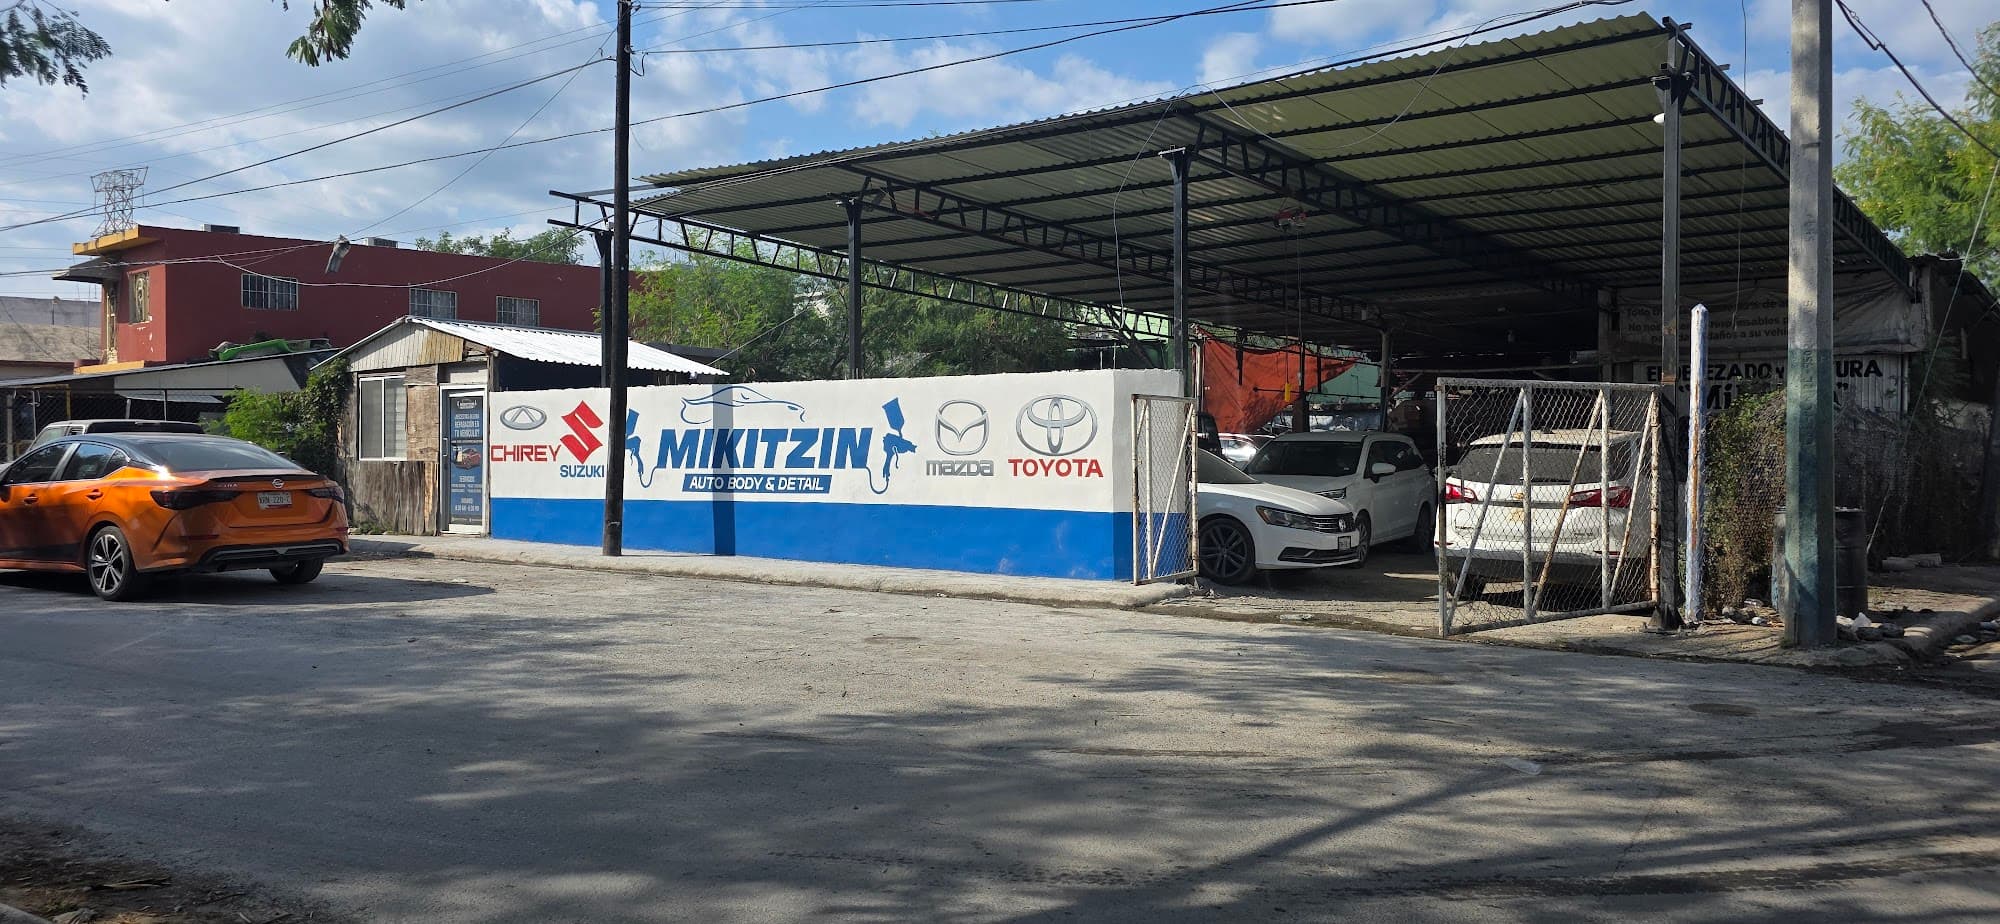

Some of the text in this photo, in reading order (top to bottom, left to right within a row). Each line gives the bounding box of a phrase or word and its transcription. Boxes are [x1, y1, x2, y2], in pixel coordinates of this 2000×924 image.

[490, 445, 561, 462] CHIREY
[656, 427, 874, 470] MIKITZIN
[559, 464, 605, 479] SUZUKI
[1008, 458, 1104, 478] TOYOTA
[688, 476, 825, 492] AUTO BODY & DETAIL
